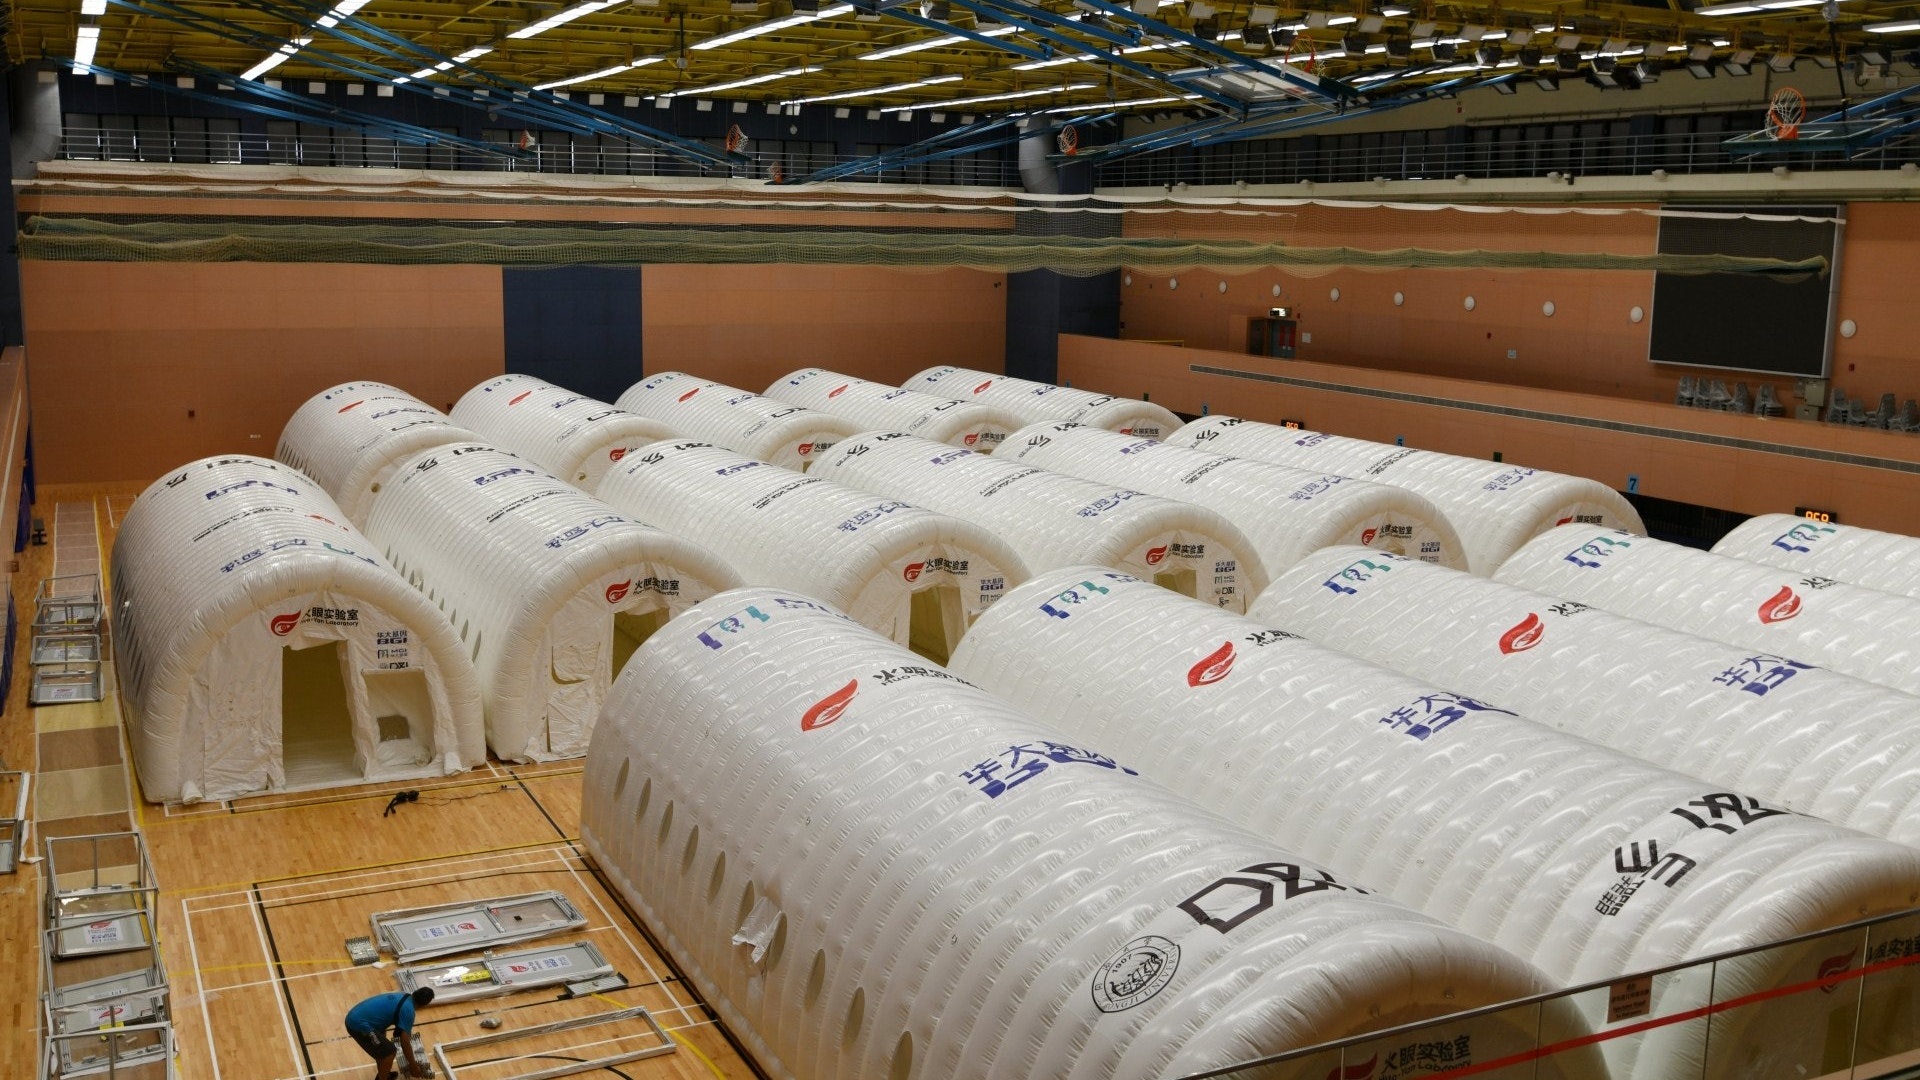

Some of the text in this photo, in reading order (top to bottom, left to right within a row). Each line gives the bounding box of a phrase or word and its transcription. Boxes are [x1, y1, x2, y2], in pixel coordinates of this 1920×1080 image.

[1629, 477, 1637, 491] 7
[377, 637, 408, 645] BGI
[1381, 1034, 1471, 1075] 火眼实验室
